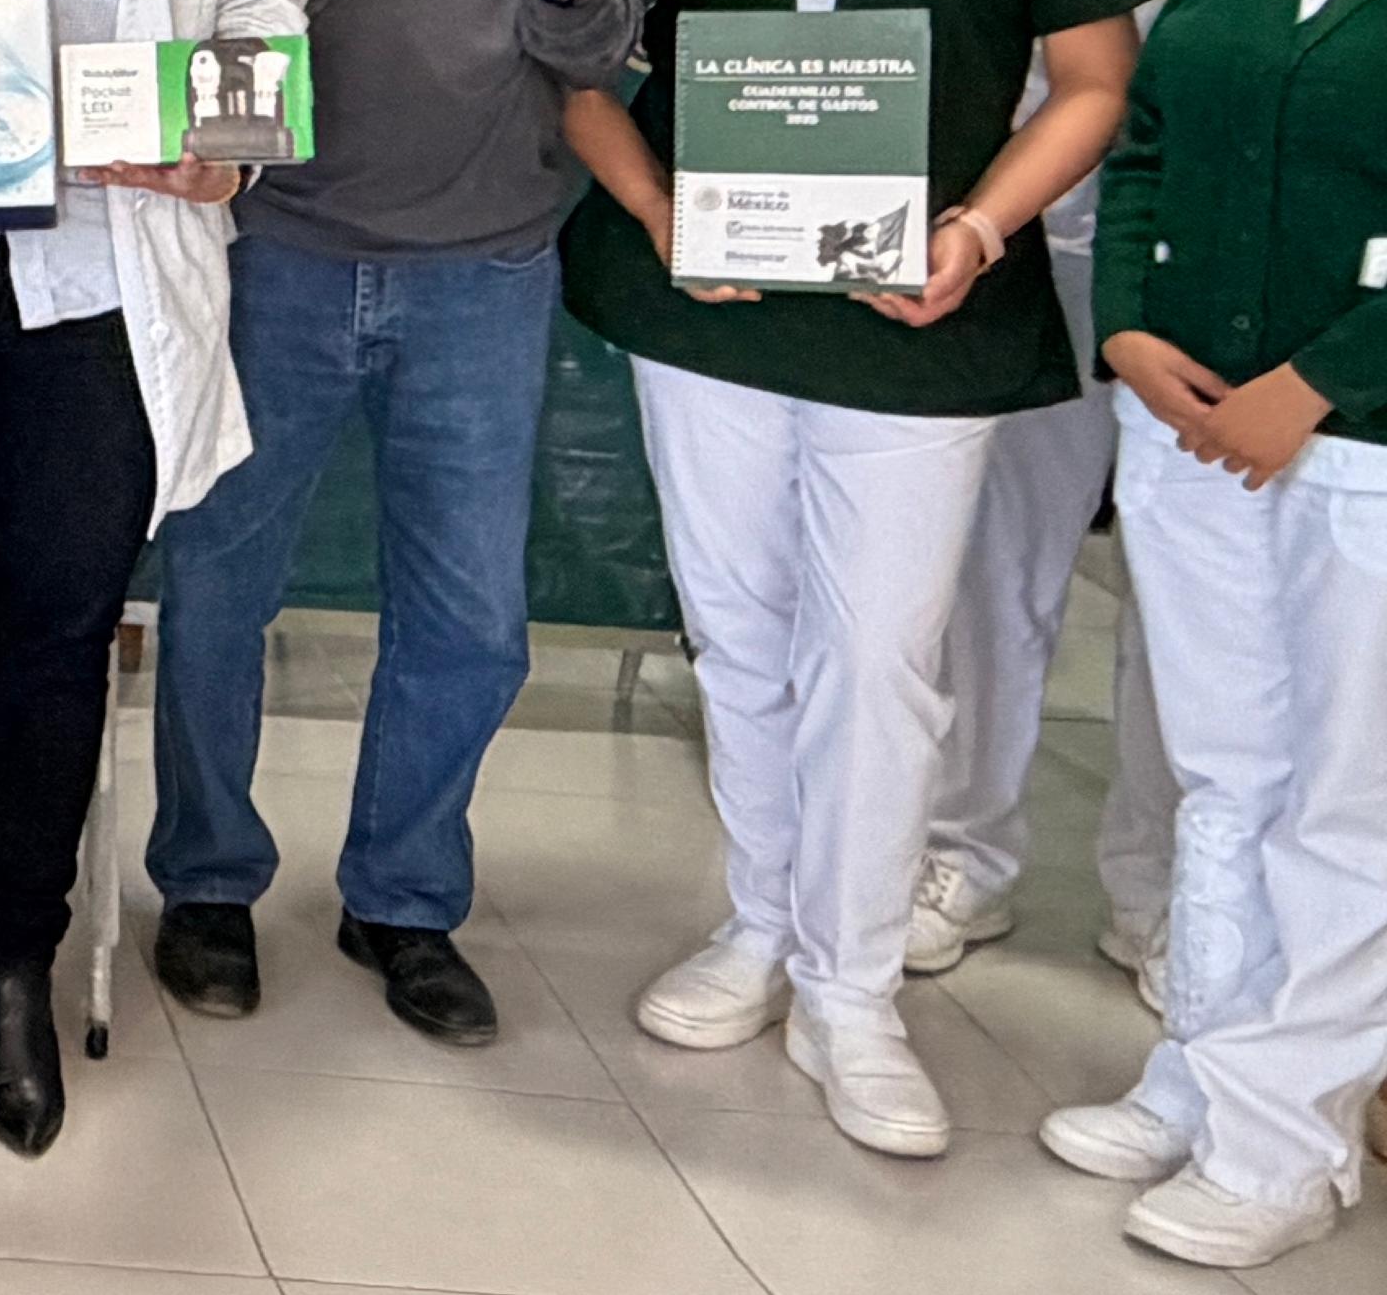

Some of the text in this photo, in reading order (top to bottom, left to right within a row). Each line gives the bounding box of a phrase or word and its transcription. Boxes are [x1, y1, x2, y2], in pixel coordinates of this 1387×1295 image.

[695, 55, 916, 75] LA CLÍNICA ES NUESTRA
[843, 85, 865, 97] DE
